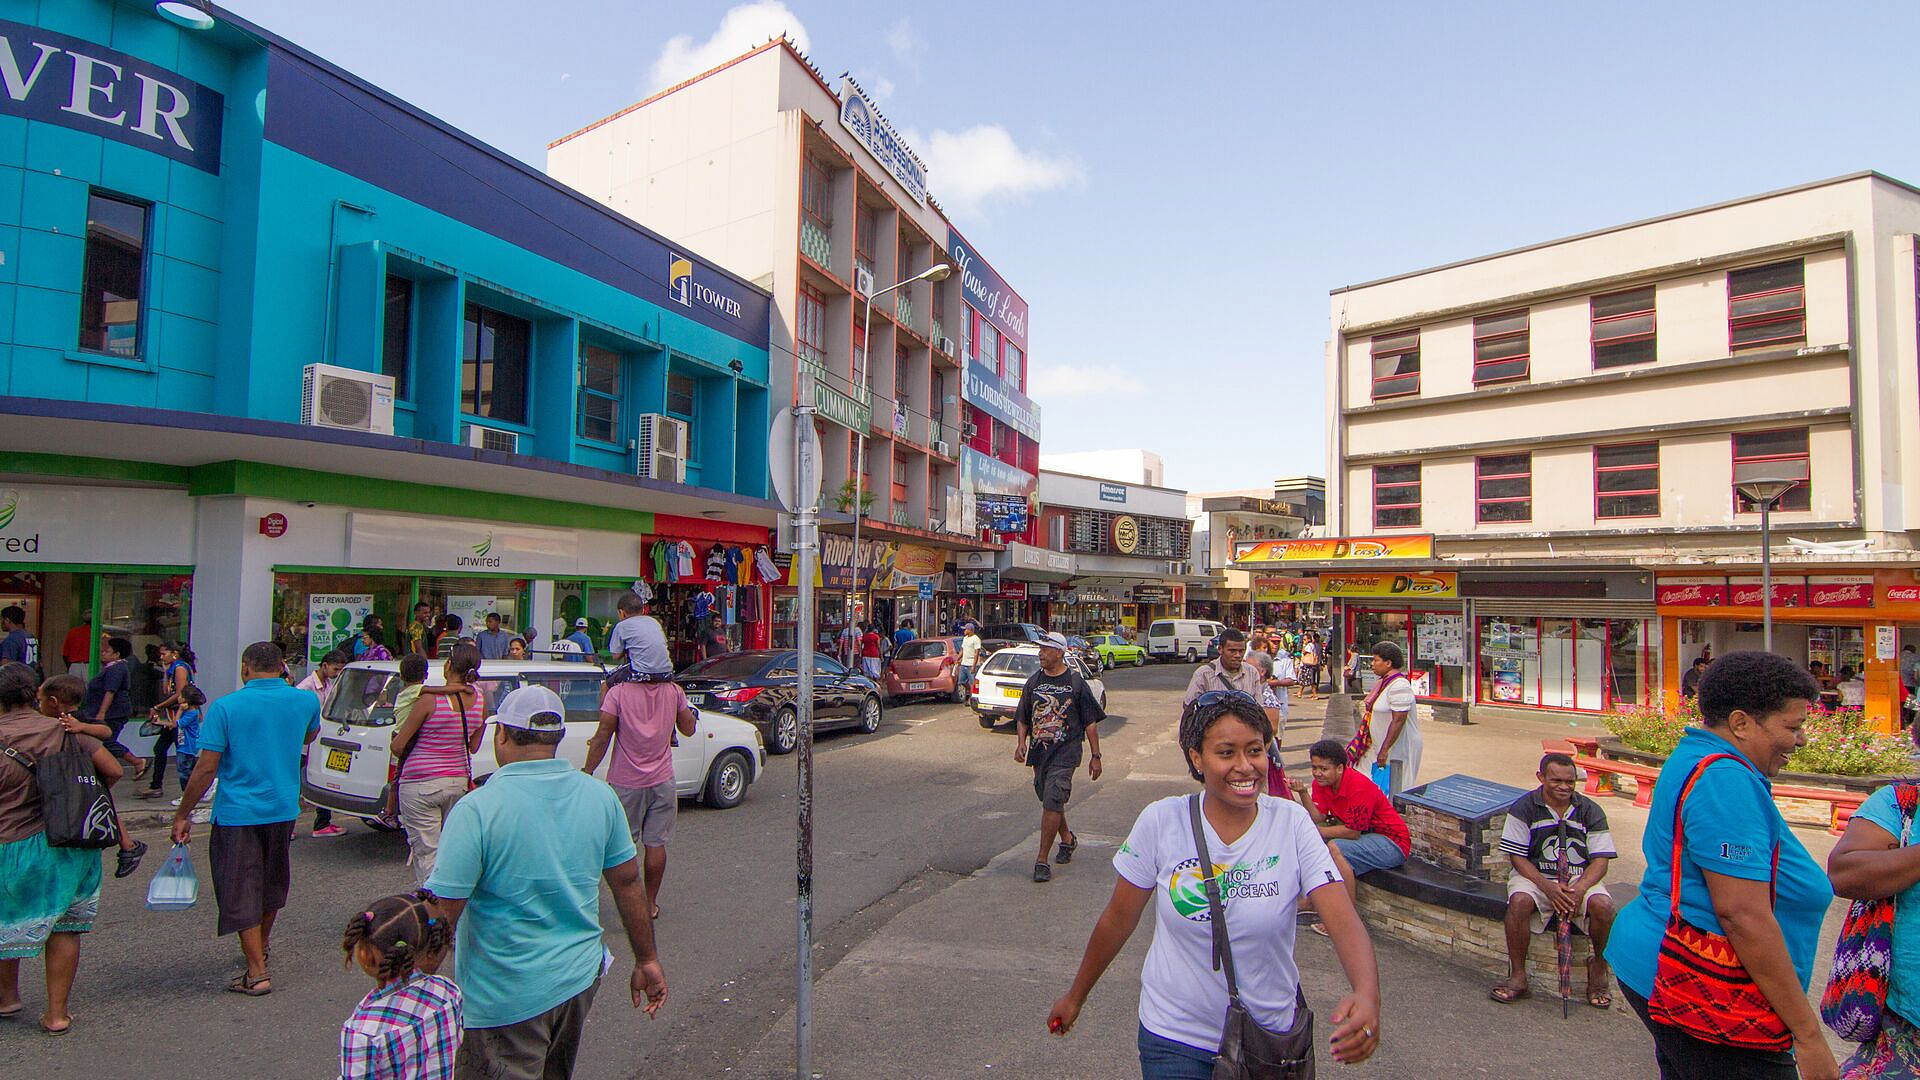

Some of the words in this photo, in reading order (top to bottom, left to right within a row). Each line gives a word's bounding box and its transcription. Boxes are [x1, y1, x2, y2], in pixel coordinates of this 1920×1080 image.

[874, 119, 924, 188] PROFESSIONAL
[693, 282, 741, 318] TOWER
[955, 246, 988, 302] House
[987, 291, 1000, 317] of
[998, 295, 1024, 338] Lords
[816, 384, 861, 429] CUMMING
[979, 380, 1003, 410] LORDS
[456, 556, 500, 567] unwired
[313, 596, 325, 604] GET
[326, 596, 362, 604] REWARDED
[1813, 585, 1862, 605] Coca-Cola
[551, 639, 570, 651] TAXI
[1227, 881, 1280, 898] OCEAN
